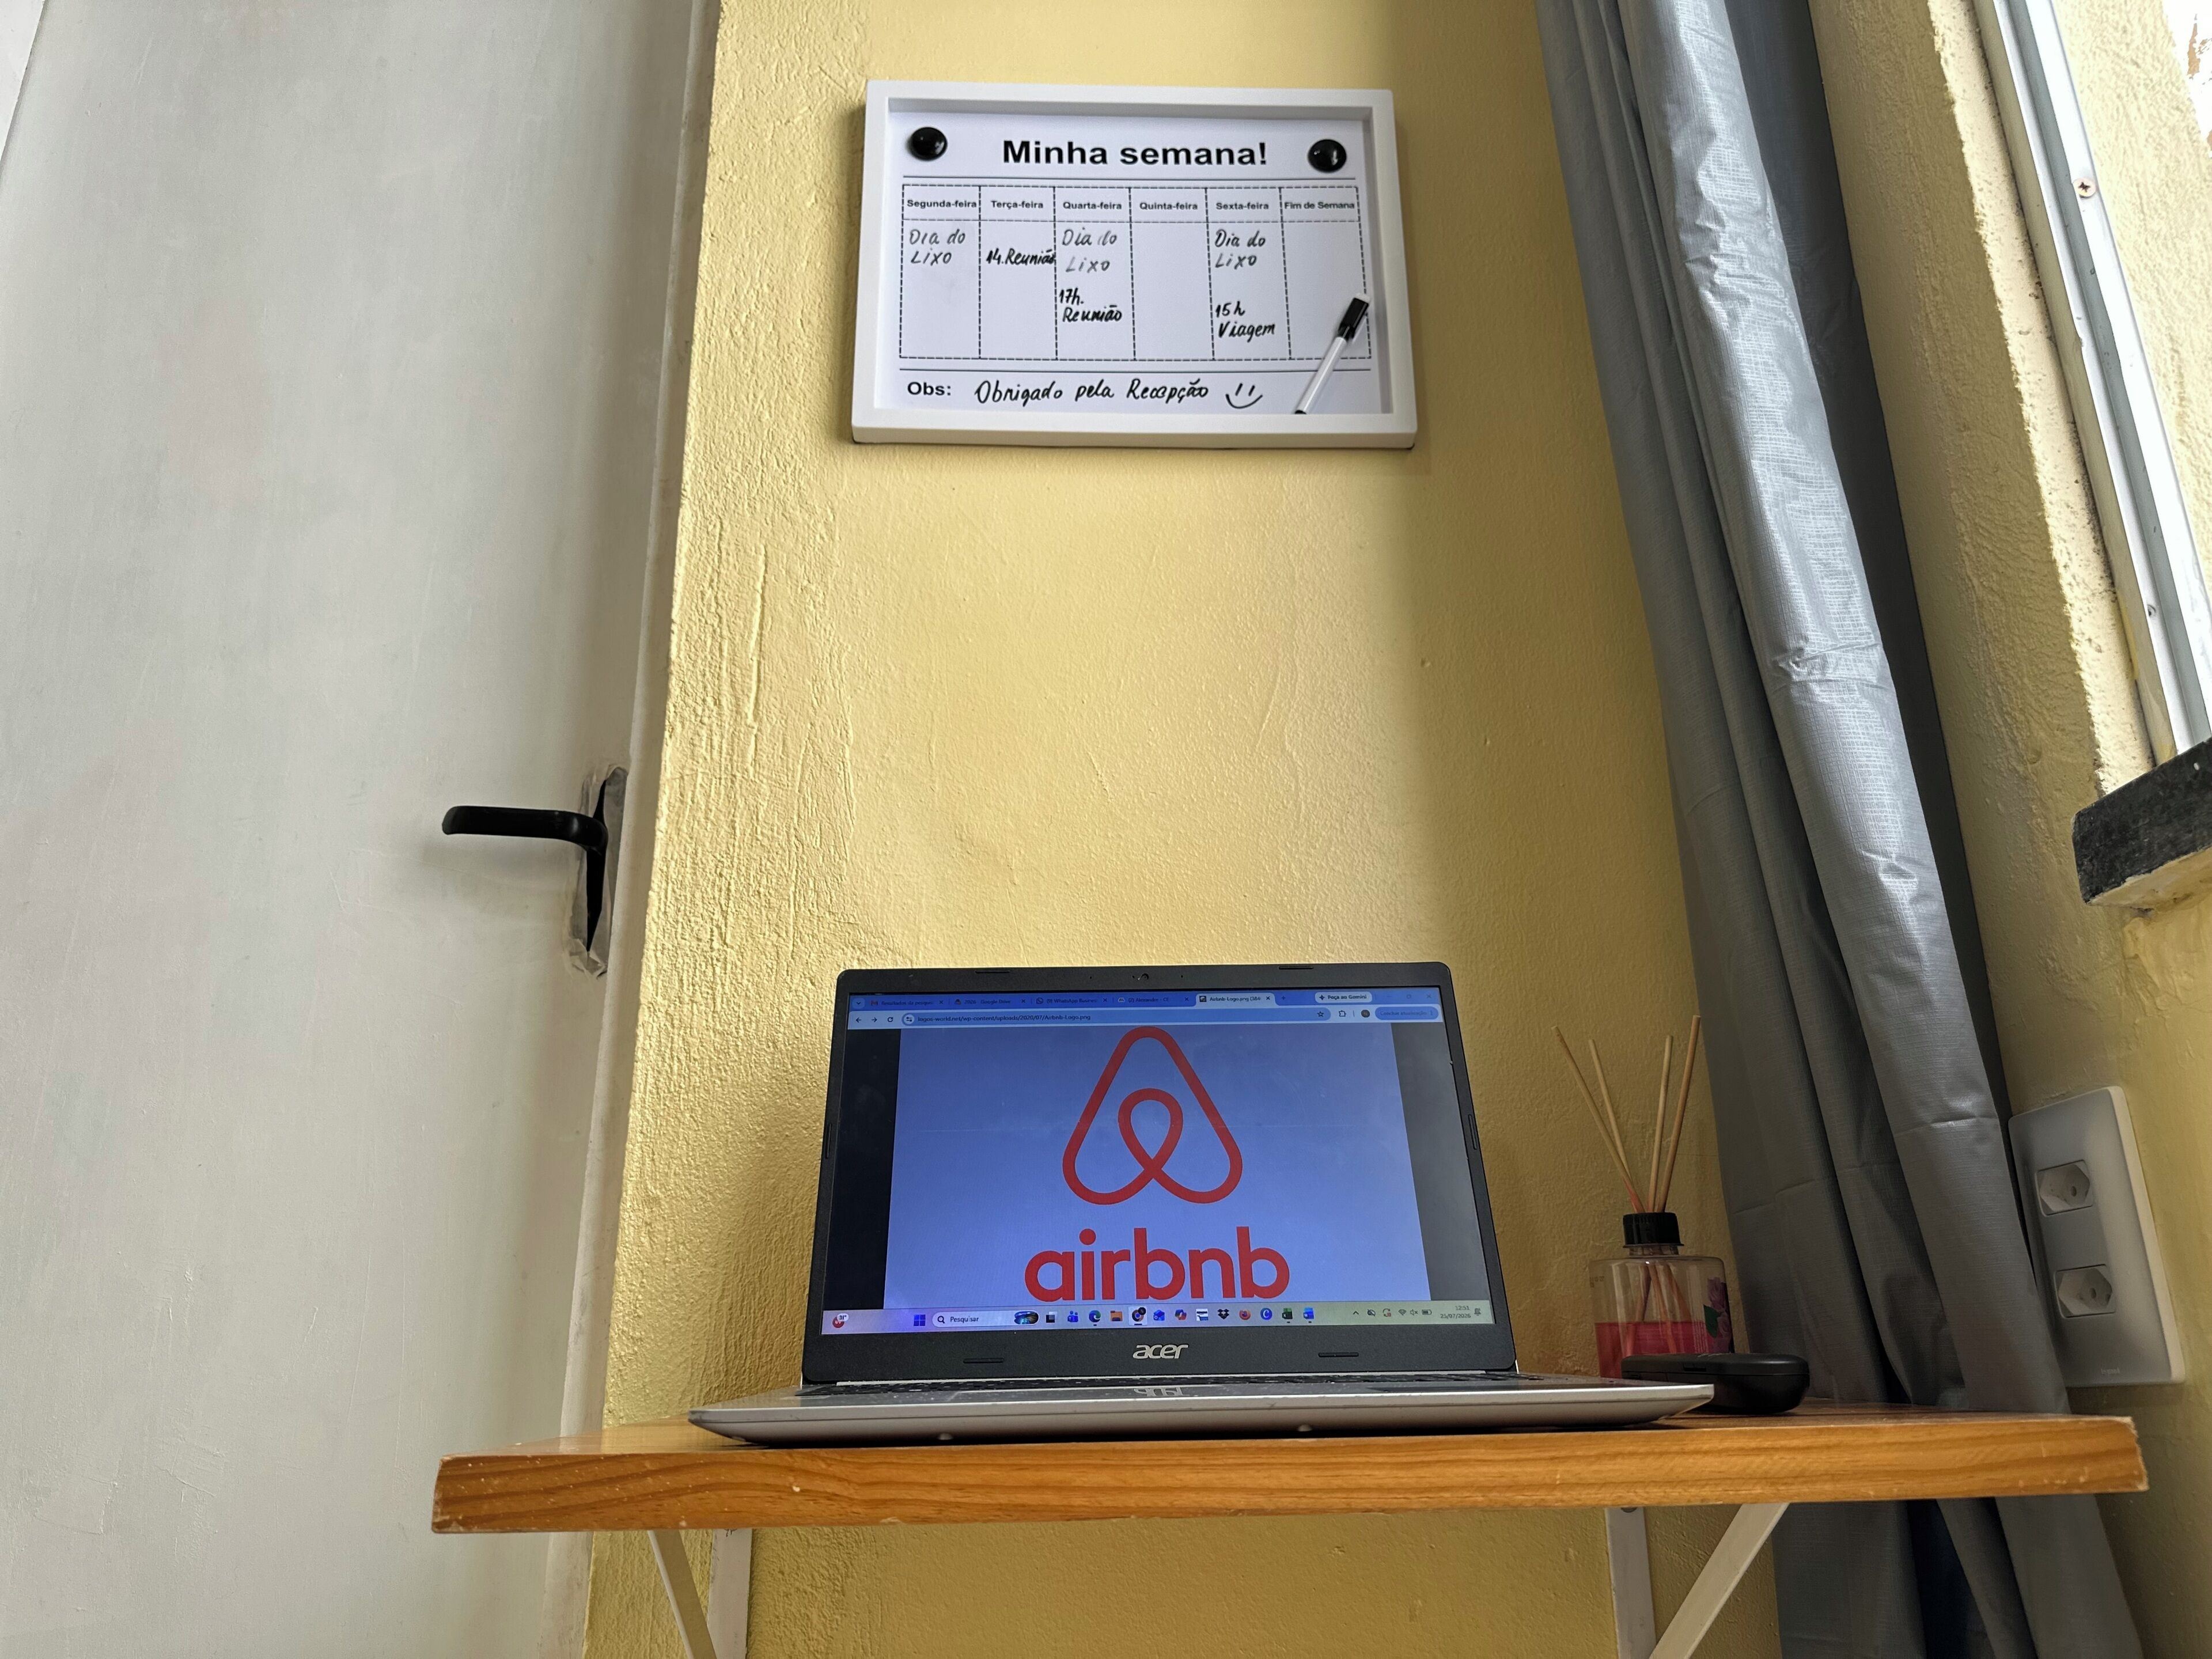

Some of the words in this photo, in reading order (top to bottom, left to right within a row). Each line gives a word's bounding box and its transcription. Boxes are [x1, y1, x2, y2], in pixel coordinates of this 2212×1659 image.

[1003, 141, 1108, 165] Minha
[1120, 142, 1267, 165] semana!
[907, 199, 977, 209] Segunda-feira
[991, 200, 1043, 210] Terça-feira
[1063, 202, 1122, 211] Quarta-feira
[1139, 202, 1198, 211] Quinta-feira
[1216, 202, 1269, 210] Sexta-feira
[1284, 202, 1302, 210] Fim
[1304, 202, 1315, 210] de
[1317, 202, 1355, 210] Semana
[946, 228, 965, 244] do
[1062, 228, 1092, 246] Dia
[1214, 229, 1240, 248] Dia
[1247, 230, 1266, 248] do
[910, 248, 952, 266] Lixo
[1065, 256, 1110, 274] Lixo
[1215, 253, 1257, 270] Lixo
[1062, 305, 1123, 323] Reunião
[1218, 321, 1275, 342] Viagem
[907, 381, 952, 396] Obs:
[974, 380, 1063, 407] Obrigado
[1074, 378, 1115, 402] pela
[1126, 377, 1209, 404] Recepção
[1024, 1226, 1290, 1302] airbnb
[950, 1316, 979, 1324] Pesquisar
[1132, 1344, 1188, 1359] acer
